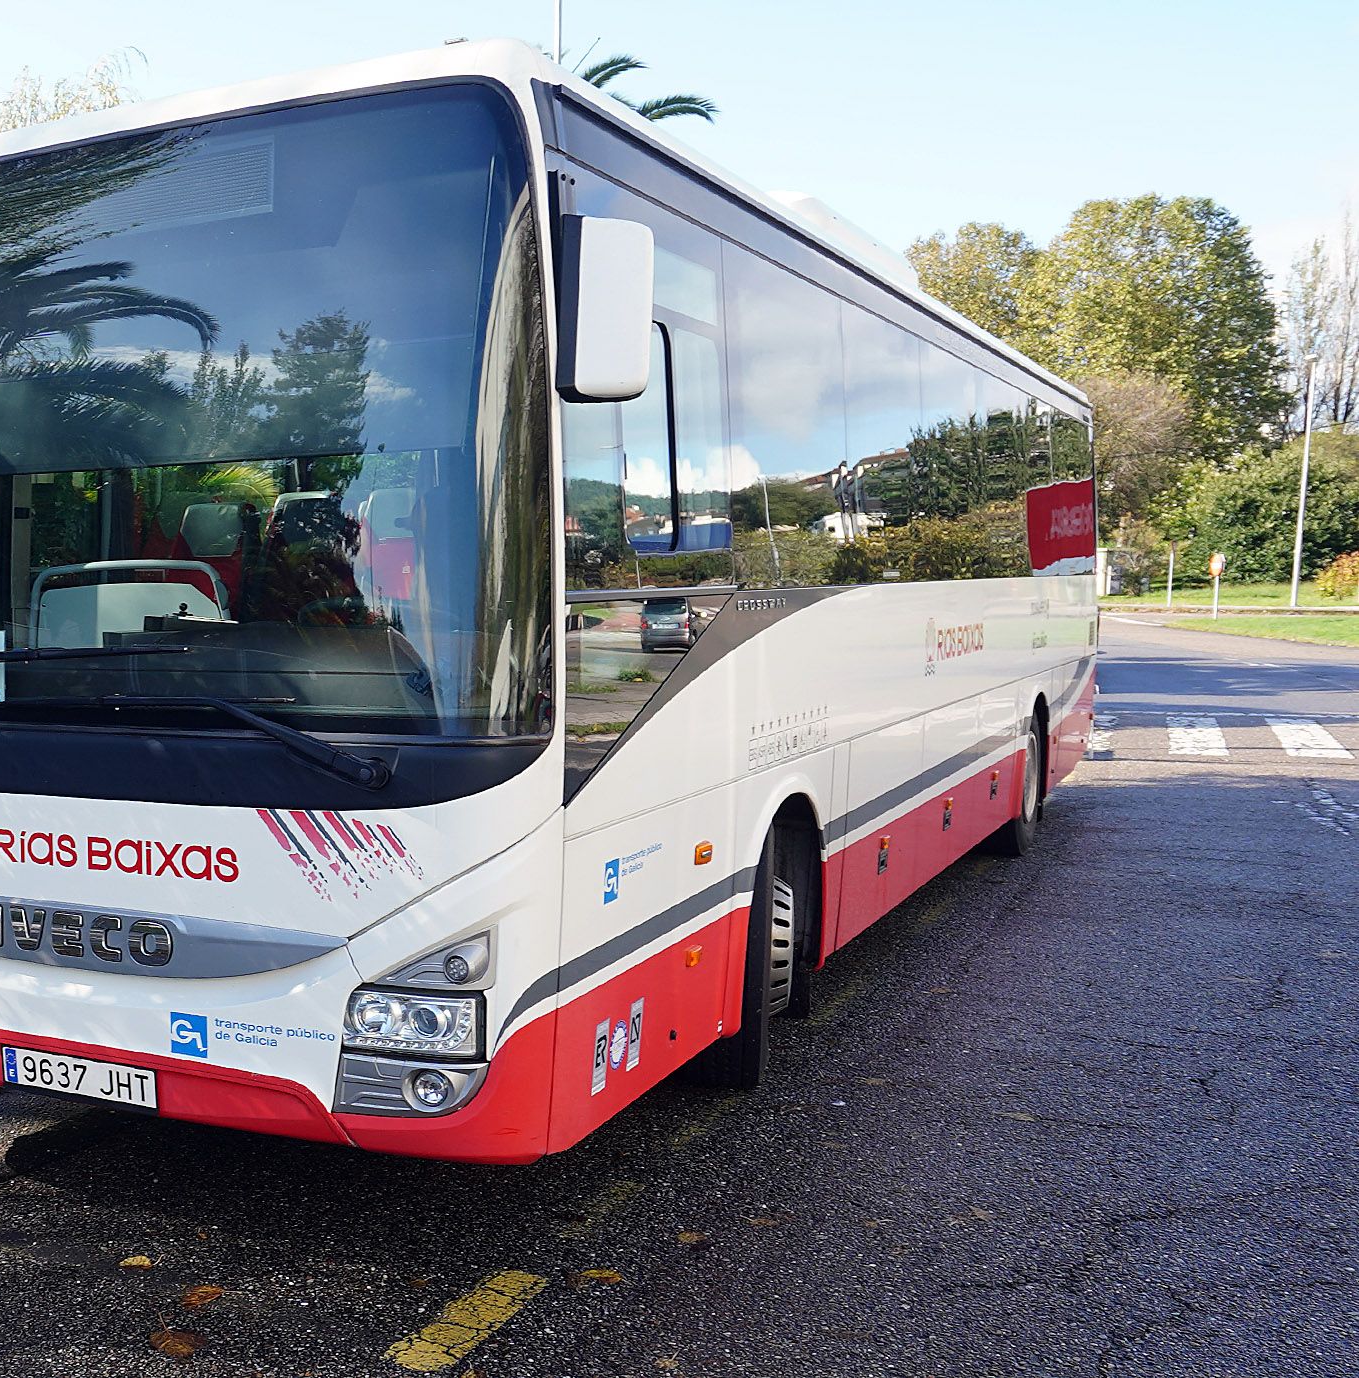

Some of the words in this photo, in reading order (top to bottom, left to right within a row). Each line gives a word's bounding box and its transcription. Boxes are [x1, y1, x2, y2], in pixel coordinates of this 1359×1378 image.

[214, 1018, 283, 1035] transporte
[287, 1027, 335, 1042] público
[215, 1030, 231, 1040] de
[235, 1033, 278, 1047] Galicia
[9, 1068, 15, 1077] E
[22, 1056, 87, 1091] 9637
[100, 1070, 149, 1102] JHT
